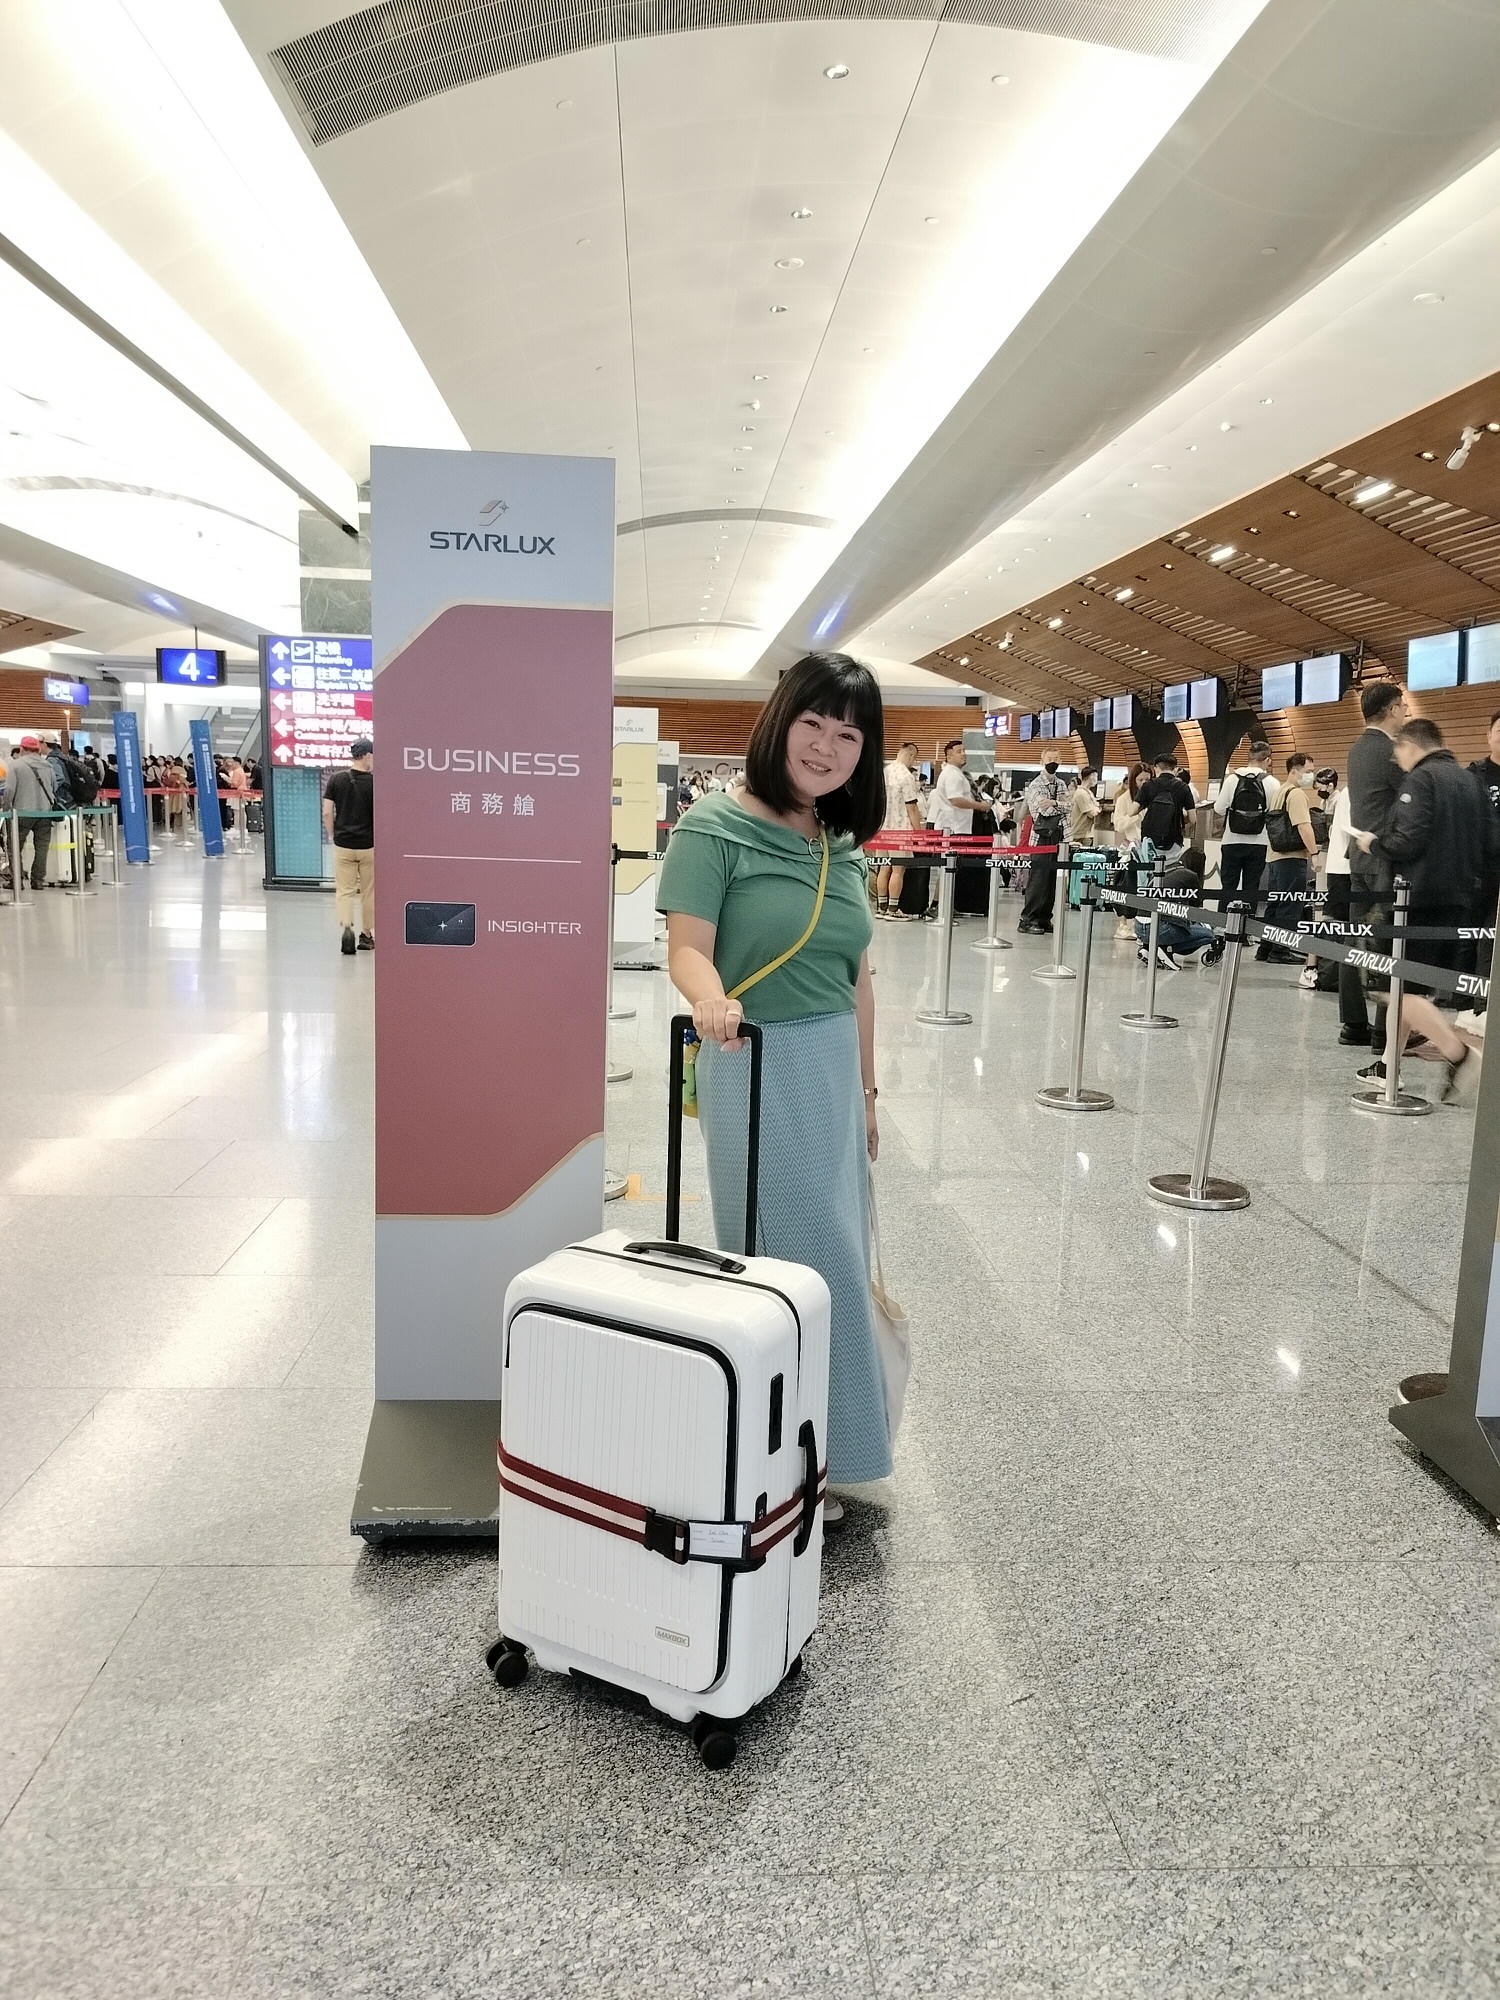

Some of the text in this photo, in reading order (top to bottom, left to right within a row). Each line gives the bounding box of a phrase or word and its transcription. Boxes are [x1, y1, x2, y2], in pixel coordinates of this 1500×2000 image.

[429, 531, 556, 556] STARLUX
[178, 652, 201, 682] 4
[403, 747, 580, 777] BUSINESS
[450, 791, 536, 817] 商務艙
[985, 859, 1032, 869] STARLUX
[1083, 862, 1129, 871] STARLUX
[1100, 888, 1128, 905] STARLUX
[1136, 887, 1198, 899] STARLUX
[1267, 891, 1329, 903] STARLUX
[1156, 901, 1190, 919] STARLUX
[487, 919, 583, 935] INSIGHTER
[1296, 920, 1374, 937] STARLUX
[1261, 925, 1303, 949] STARLUX
[1343, 948, 1398, 975] STARLUX
